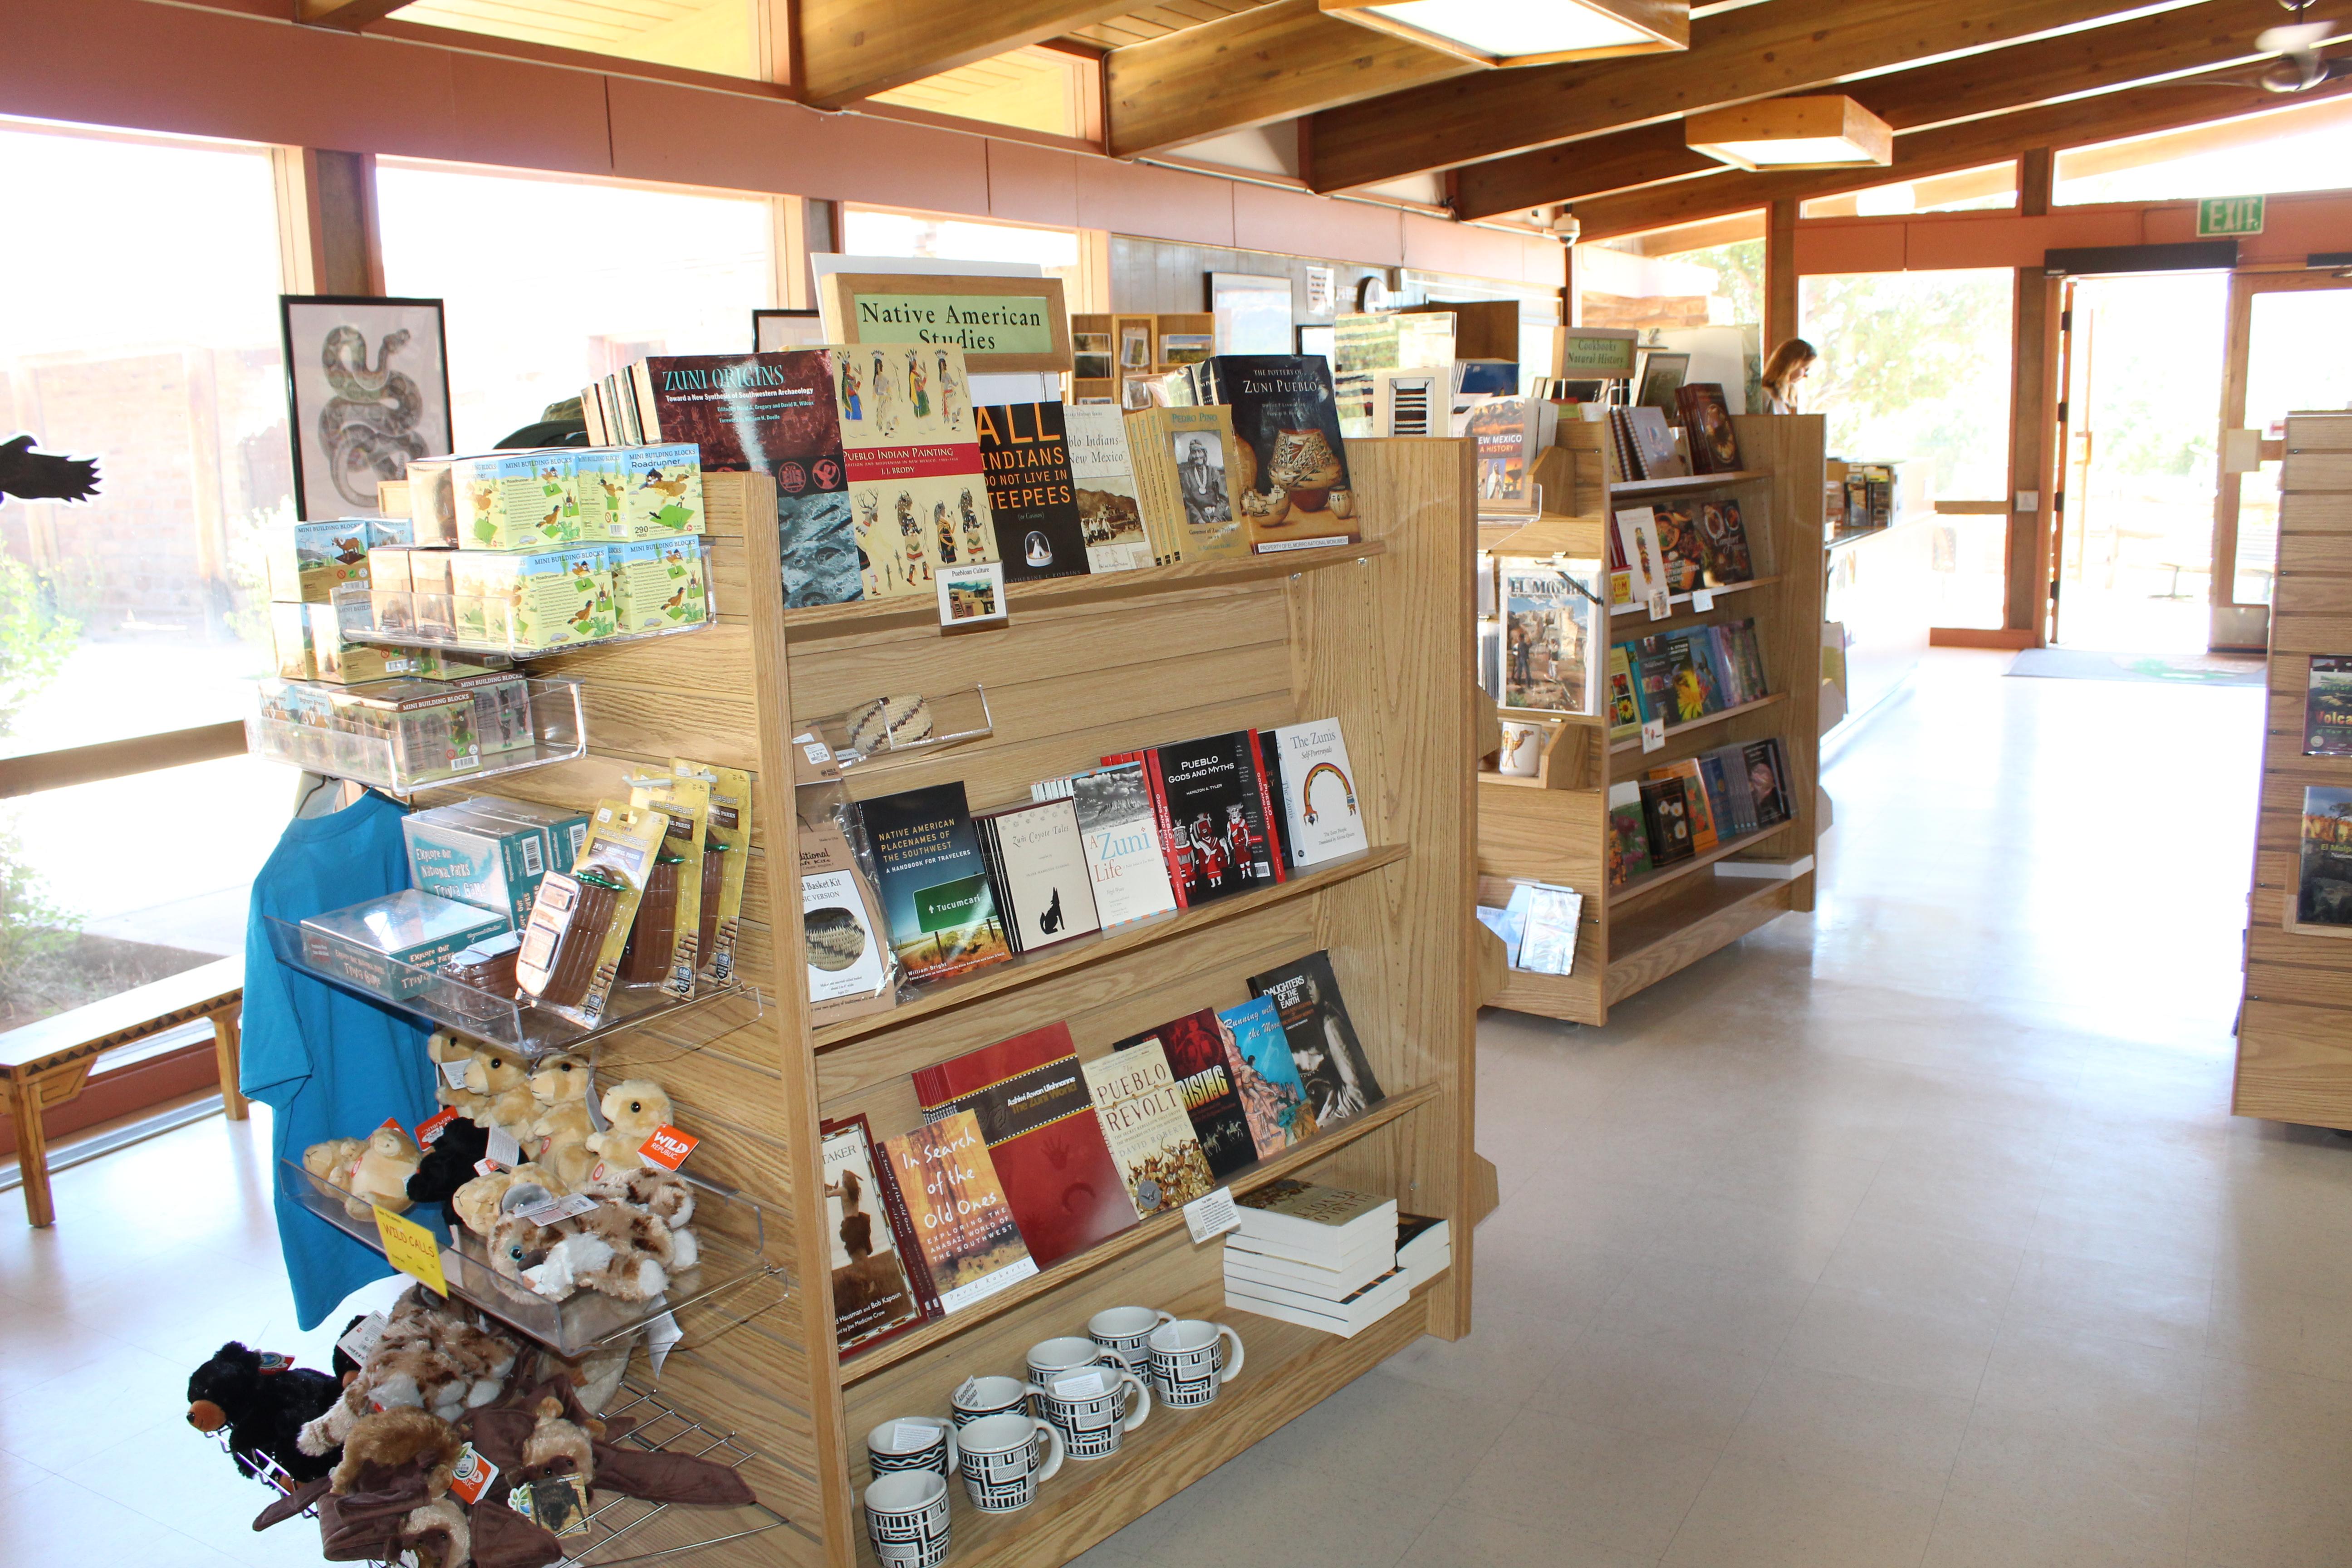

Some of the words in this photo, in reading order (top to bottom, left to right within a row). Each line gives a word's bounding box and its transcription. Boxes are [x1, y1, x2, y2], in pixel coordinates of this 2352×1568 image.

[2209, 200, 2259, 231] EXIT
[860, 303, 935, 323] Native
[946, 304, 1040, 326] American
[919, 329, 995, 349] Studies
[1578, 340, 1616, 350] Cookbooks
[1568, 353, 1595, 363] Natural
[1597, 353, 1624, 367] History
[662, 369, 708, 391] ZUNI
[712, 364, 784, 389] ORIGINS
[1243, 380, 1272, 393] ZUNI
[1277, 379, 1317, 392] PUEBLO
[704, 392, 730, 402] Synthesis
[739, 390, 777, 398] Southwestern
[778, 387, 813, 396] Archaeology
[976, 402, 1060, 447] ALL
[1172, 413, 1197, 423] PEDRO
[1200, 412, 1217, 421] PINO
[1478, 436, 1491, 445] EW
[1493, 434, 1522, 444] MEXICO
[631, 458, 681, 469] Roadrunner
[843, 451, 874, 463] PUEBLO
[877, 449, 909, 460] INDIAN
[912, 447, 953, 457] PAINTING
[982, 446, 1064, 470] INDIANS
[1069, 454, 1087, 464] New
[1092, 451, 1123, 463] Mexico
[892, 466, 915, 474] BRODY
[1000, 474, 1019, 485] NOT
[1025, 471, 1050, 483] LIVE
[1055, 470, 1067, 480] IN
[988, 485, 1070, 510] TEEPEES
[635, 525, 648, 534] 290
[1290, 736, 1309, 749] The
[1310, 729, 1336, 745] Zunis
[1181, 756, 1218, 770] PUEBLO
[1301, 746, 1333, 760] Self-Portrayals
[1168, 772, 1191, 783] GODS
[1192, 769, 1207, 778] AND
[1208, 763, 1235, 774] MYTHS
[597, 826, 620, 841] TRIVIAL
[621, 833, 649, 849] PURSUIT
[879, 828, 909, 841] NATIVE
[912, 818, 955, 834] AMERICAN
[1012, 834, 1026, 848] Zuñi
[1029, 830, 1049, 843] Coyote
[1052, 824, 1069, 834] Tales
[881, 834, 936, 852] PLACENAMES
[940, 830, 950, 839] OF
[1090, 835, 1098, 849] A
[1097, 829, 1152, 860] Zuni
[883, 853, 900, 863] THE
[902, 841, 951, 858] SOUTHWEST
[892, 861, 923, 872] HANDBOOK
[937, 849, 971, 861] TRAVELERS
[1094, 859, 1123, 882] Life
[807, 881, 830, 891] Basket
[830, 878, 842, 887] Kit
[812, 891, 840, 901] VERSION
[936, 894, 980, 912] Tucumcari
[679, 968, 690, 976] 600
[908, 967, 928, 976] William
[930, 962, 947, 970] Bright
[1263, 975, 1304, 996] DAUGHTERS
[1278, 991, 1287, 1001] OF
[1288, 988, 1298, 998] THE
[1280, 996, 1300, 1009] EARTH
[1224, 1011, 1259, 1029] Running
[1262, 1001, 1274, 1015] with
[1249, 1028, 1260, 1039] the
[1262, 1022, 1280, 1034] Moon
[1097, 1063, 1166, 1105] PUEBLO
[1175, 1065, 1230, 1111] RISING
[1106, 1088, 1177, 1132] REVOLT
[1137, 1119, 1157, 1131] REBELLION
[654, 1131, 689, 1154] WILD
[903, 1153, 920, 1170] In
[924, 1126, 976, 1163] Search
[1119, 1140, 1147, 1157] DAVID
[1151, 1123, 1188, 1144] ROBERTS
[651, 1142, 678, 1160] REPUBLIC
[822, 1145, 857, 1165] TAKER
[927, 1171, 944, 1195] of
[949, 1164, 975, 1186] the
[924, 1202, 953, 1229] Old
[958, 1192, 997, 1215] Ones
[927, 1218, 983, 1245] EXPLORING
[988, 1207, 1007, 1219] THE
[931, 1235, 965, 1254] ANASAZI
[969, 1222, 995, 1236] WORLD
[999, 1216, 1009, 1225] OF
[383, 1222, 407, 1243] WILD
[409, 1235, 435, 1257] CALLS
[933, 1251, 951, 1262] THE
[957, 1224, 1013, 1253] SOUTHWEST
[839, 1308, 863, 1323] Hausman
[871, 1301, 882, 1309] Bob
[882, 1292, 902, 1304] Kapoun
[854, 1315, 873, 1327] Medicine
[873, 1310, 885, 1318] Crow
[958, 1379, 975, 1403] Ancestral
